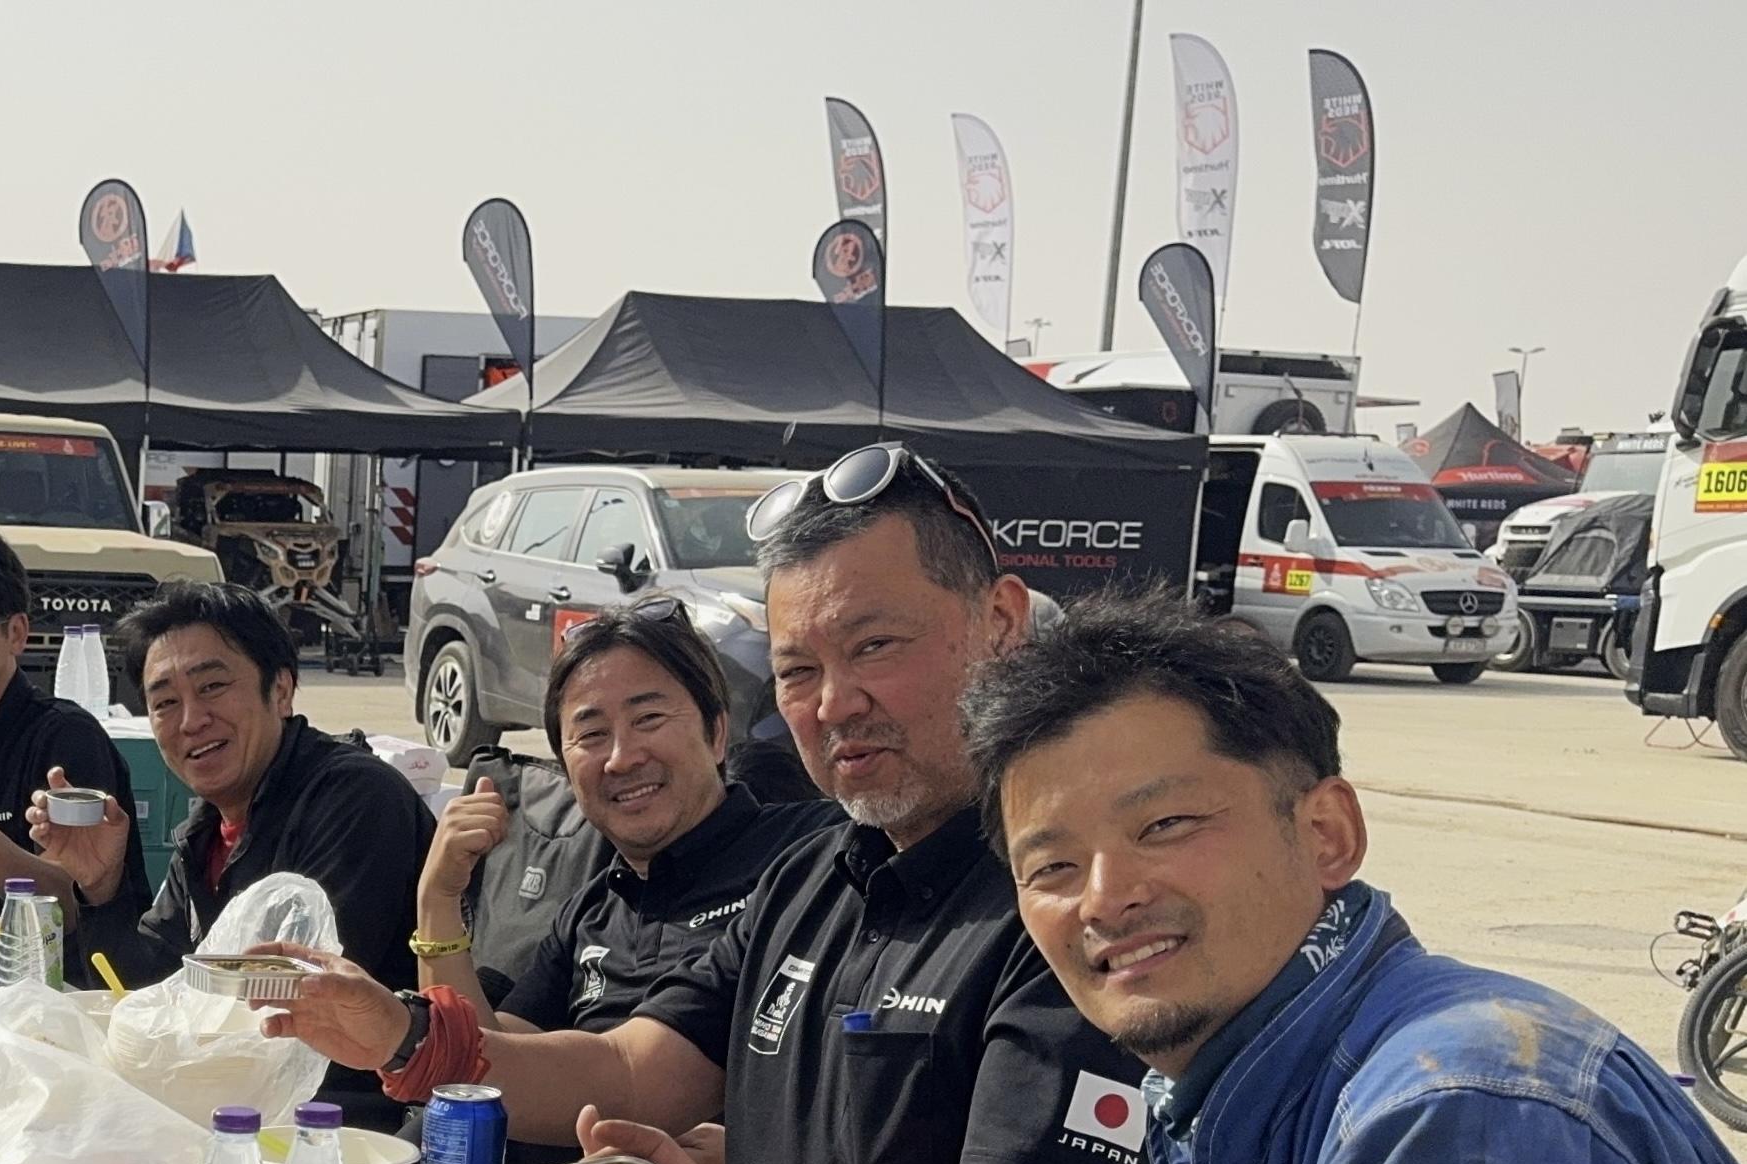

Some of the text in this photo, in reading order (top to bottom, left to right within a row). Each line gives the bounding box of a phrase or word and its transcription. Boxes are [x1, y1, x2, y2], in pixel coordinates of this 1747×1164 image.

[1704, 470, 1747, 494] 1606
[1445, 499, 1507, 510] WHITE REDS
[988, 519, 1144, 549] KFORCE
[1065, 554, 1117, 569] TOOLS
[41, 597, 112, 612] TOYOTA
[708, 895, 753, 920] HIN
